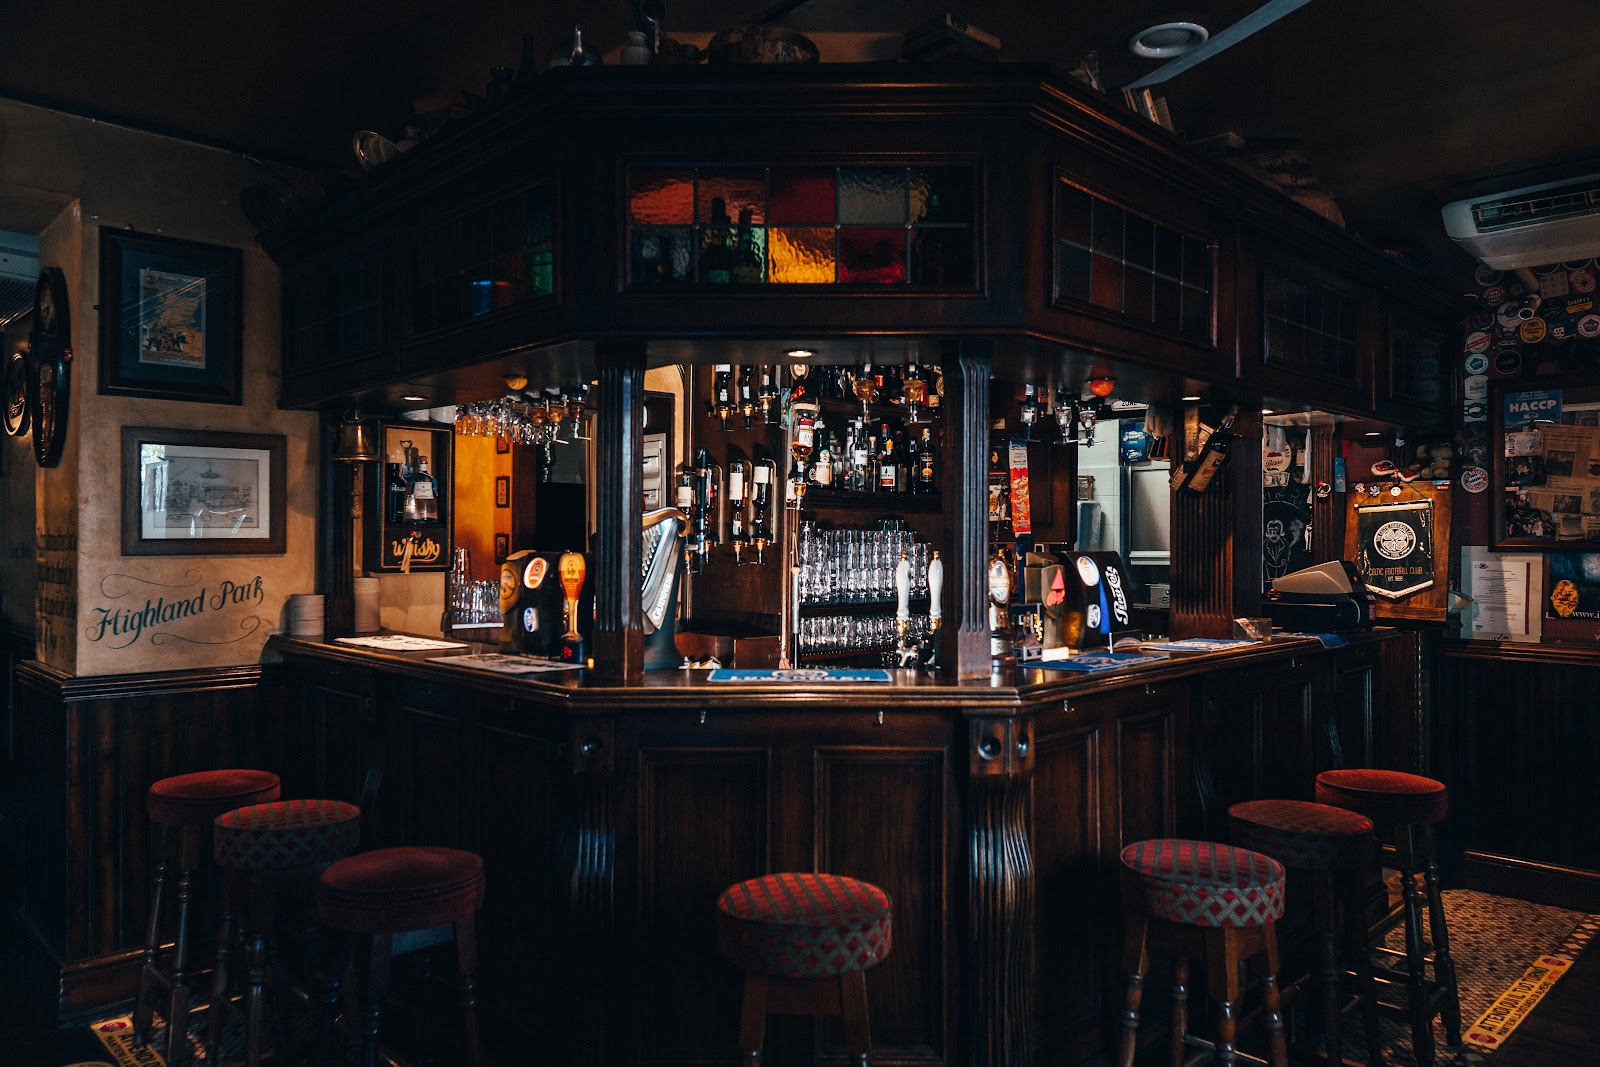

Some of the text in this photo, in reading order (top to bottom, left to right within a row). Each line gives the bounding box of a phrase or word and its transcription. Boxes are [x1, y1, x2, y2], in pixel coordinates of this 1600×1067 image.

[1509, 399, 1557, 413] HACCP
[1385, 567, 1408, 575] FOOTBALL
[1410, 566, 1423, 574] CLUB
[86, 588, 205, 649] Highland
[209, 576, 265, 611] Park
[652, 572, 674, 621] GUINNESS
[1478, 1005, 1511, 1031] ATTENDI
[1512, 982, 1535, 994] TUO
